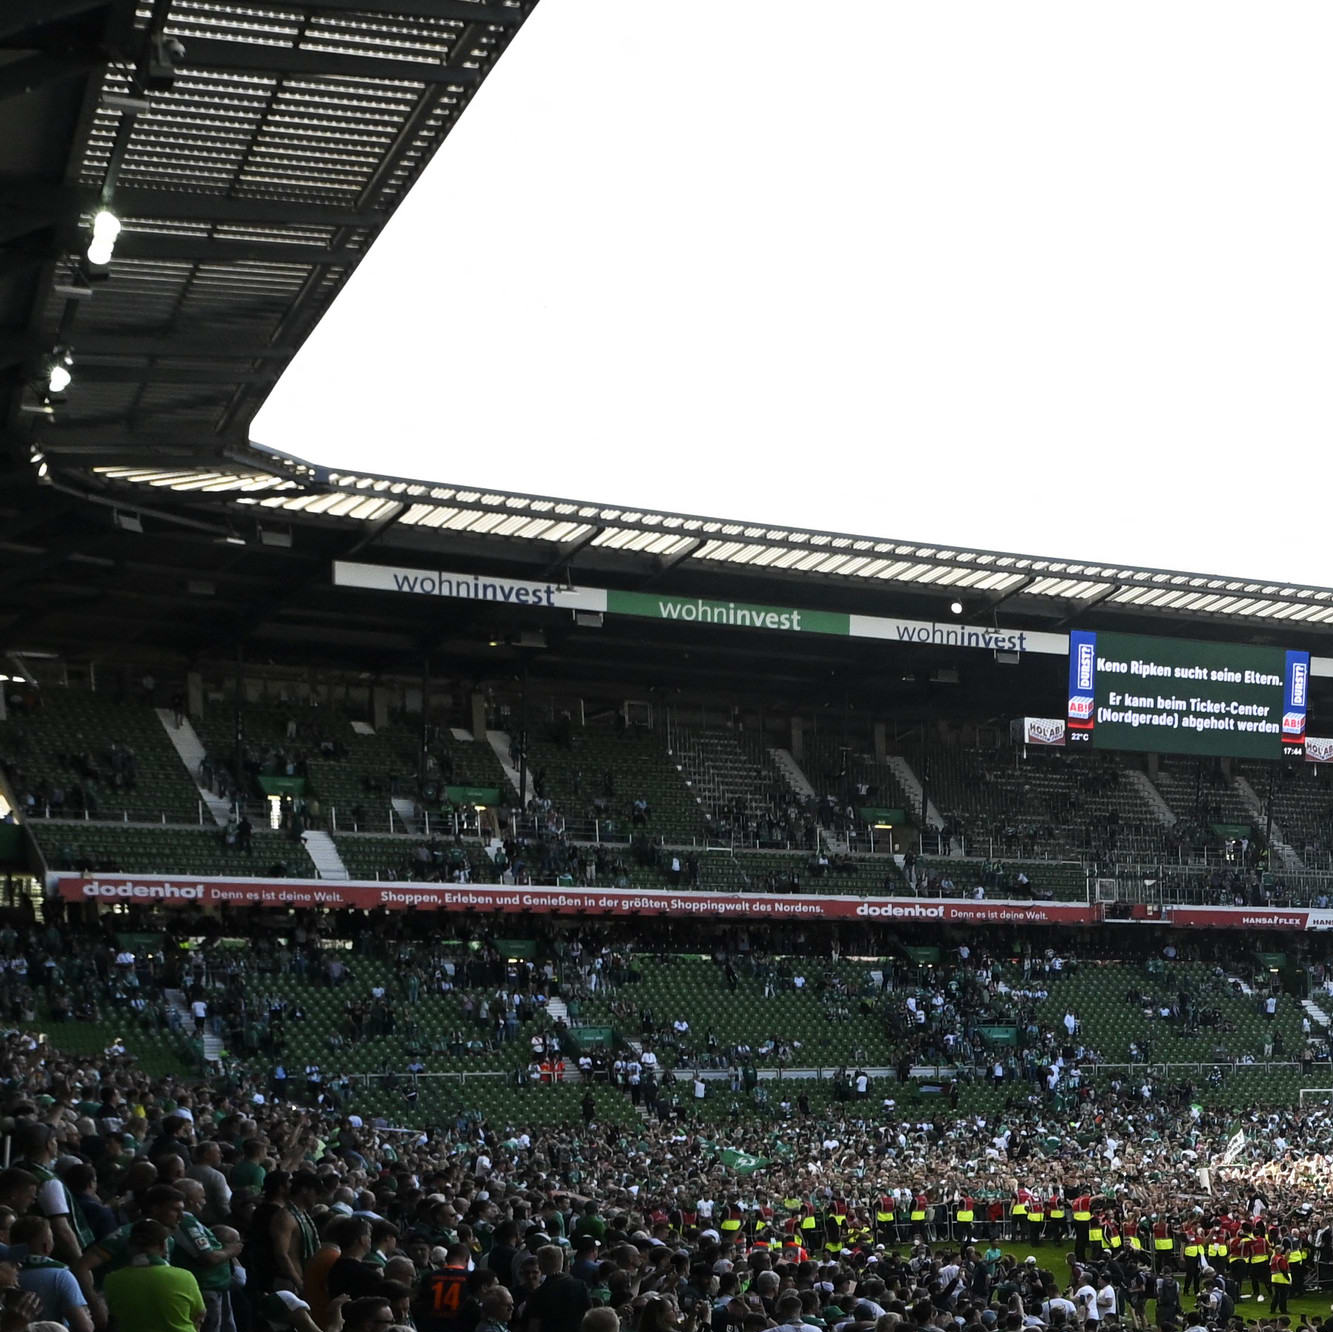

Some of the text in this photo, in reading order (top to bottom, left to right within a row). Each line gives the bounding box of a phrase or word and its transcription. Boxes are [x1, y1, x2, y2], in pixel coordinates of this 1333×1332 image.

[393, 572, 555, 606] wohninvest
[658, 600, 801, 631] wohninvest
[896, 621, 1027, 652] wohninvest
[1080, 645, 1092, 688] DURST?
[1097, 658, 1283, 686] Keno Ripken sucht seine Eltern.
[1294, 665, 1305, 704] DURST?
[1109, 693, 1269, 717] Er kann beim Ticket-Center
[1097, 708, 1279, 734] (Nordgerade) abgeholt werden
[83, 883, 344, 902] dodenhof Denn es ist deine Welt.
[381, 891, 824, 914] Shoppen, Erleben und Genießen in der größten Shoppingwelt des Nordens.
[856, 904, 944, 918] dodenhof
[950, 909, 974, 919] Denn
[988, 910, 999, 919] ist
[1000, 910, 1023, 920] deine
[1025, 910, 1048, 920] Welt.
[432, 1282, 461, 1310] 14
